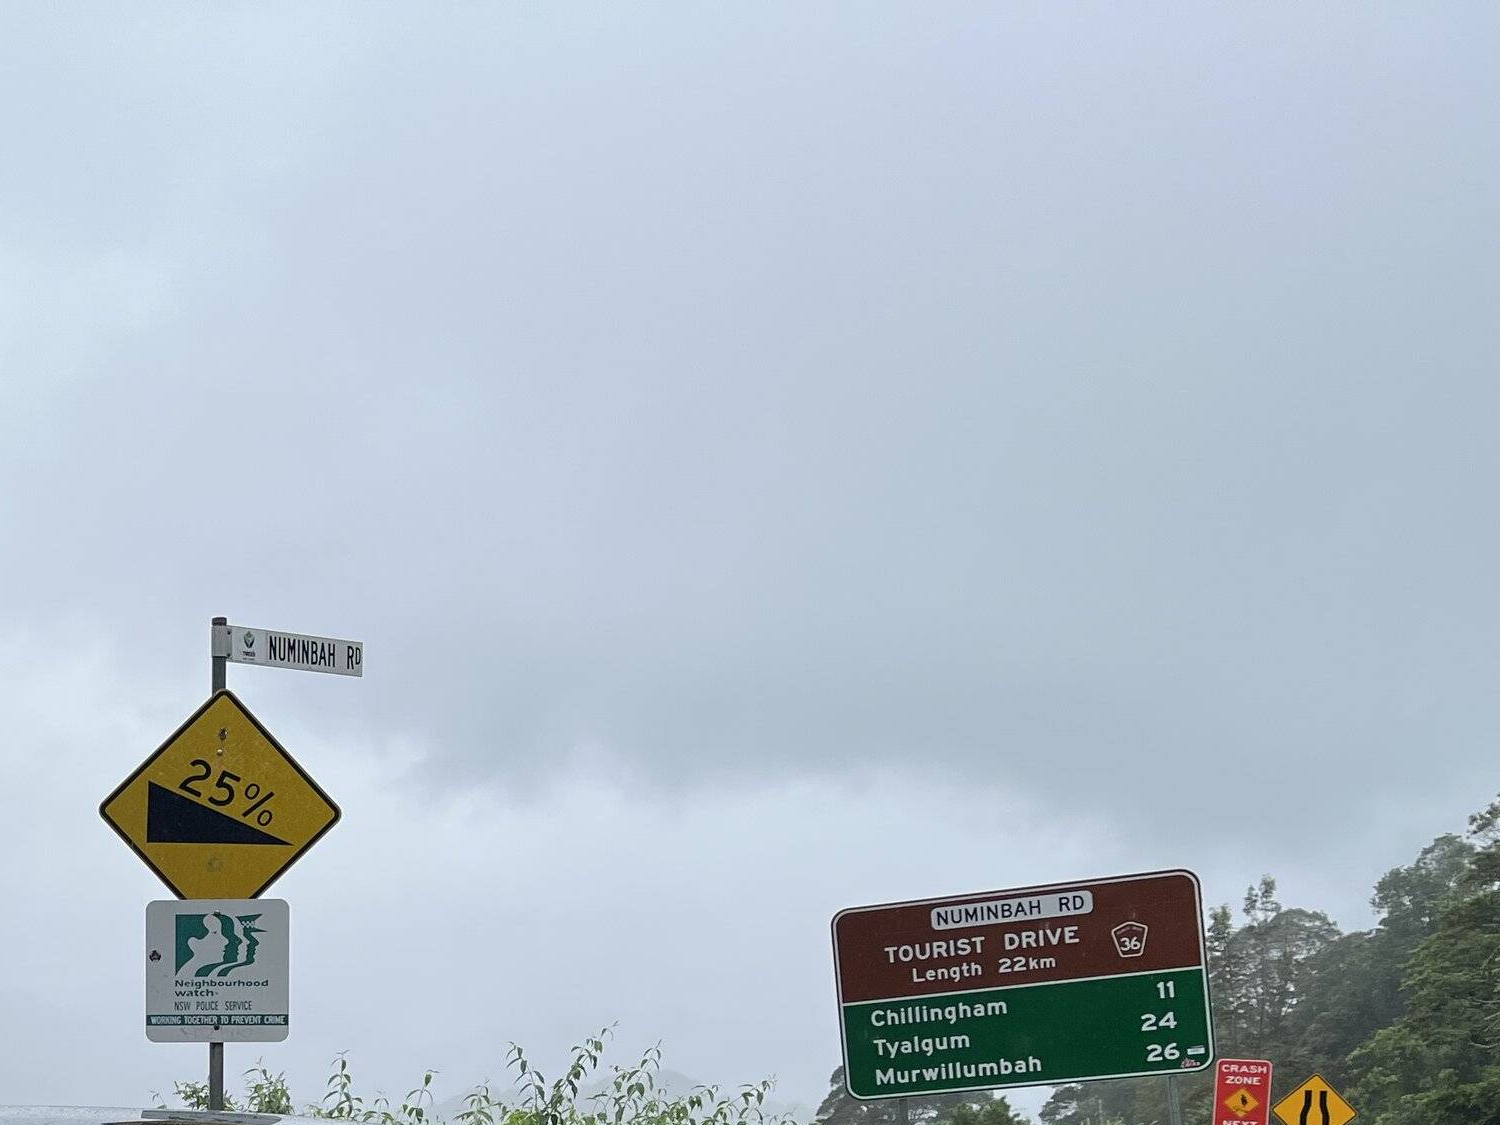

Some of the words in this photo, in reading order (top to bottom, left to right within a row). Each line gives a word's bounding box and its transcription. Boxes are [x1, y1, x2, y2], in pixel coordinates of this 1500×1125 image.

[268, 635, 336, 668] NUMINBAH
[346, 645, 361, 670] RD
[178, 758, 275, 827] 25%
[936, 901, 1042, 926] NUMINBAH
[1059, 895, 1084, 912] RD
[884, 936, 985, 963] TOURIST
[1004, 926, 1080, 950] DRIVE
[1120, 936, 1141, 951] 36
[912, 963, 982, 983] Length
[998, 955, 1056, 973] 22km
[174, 979, 269, 989] Neighbourhood
[174, 989, 214, 997] watch
[174, 1001, 191, 1010] NSW
[196, 1001, 219, 1010] POLICE
[225, 1001, 252, 1010] SERVICE
[870, 1000, 1008, 1027] Chillingham
[1157, 981, 1175, 999] 11
[150, 1016, 181, 1024] WORKING
[184, 1016, 218, 1024] TOGETHER
[220, 1016, 228, 1024] TO
[231, 1016, 262, 1024] PREVENT
[264, 1016, 285, 1024] CRIME
[873, 1033, 970, 1059] Tyalgum
[1140, 1011, 1178, 1031] 24
[875, 1056, 1042, 1086] Murwillumbah
[1146, 1043, 1180, 1062] 26
[1221, 1064, 1268, 1074] CRASH
[1225, 1075, 1261, 1085] ZONE
